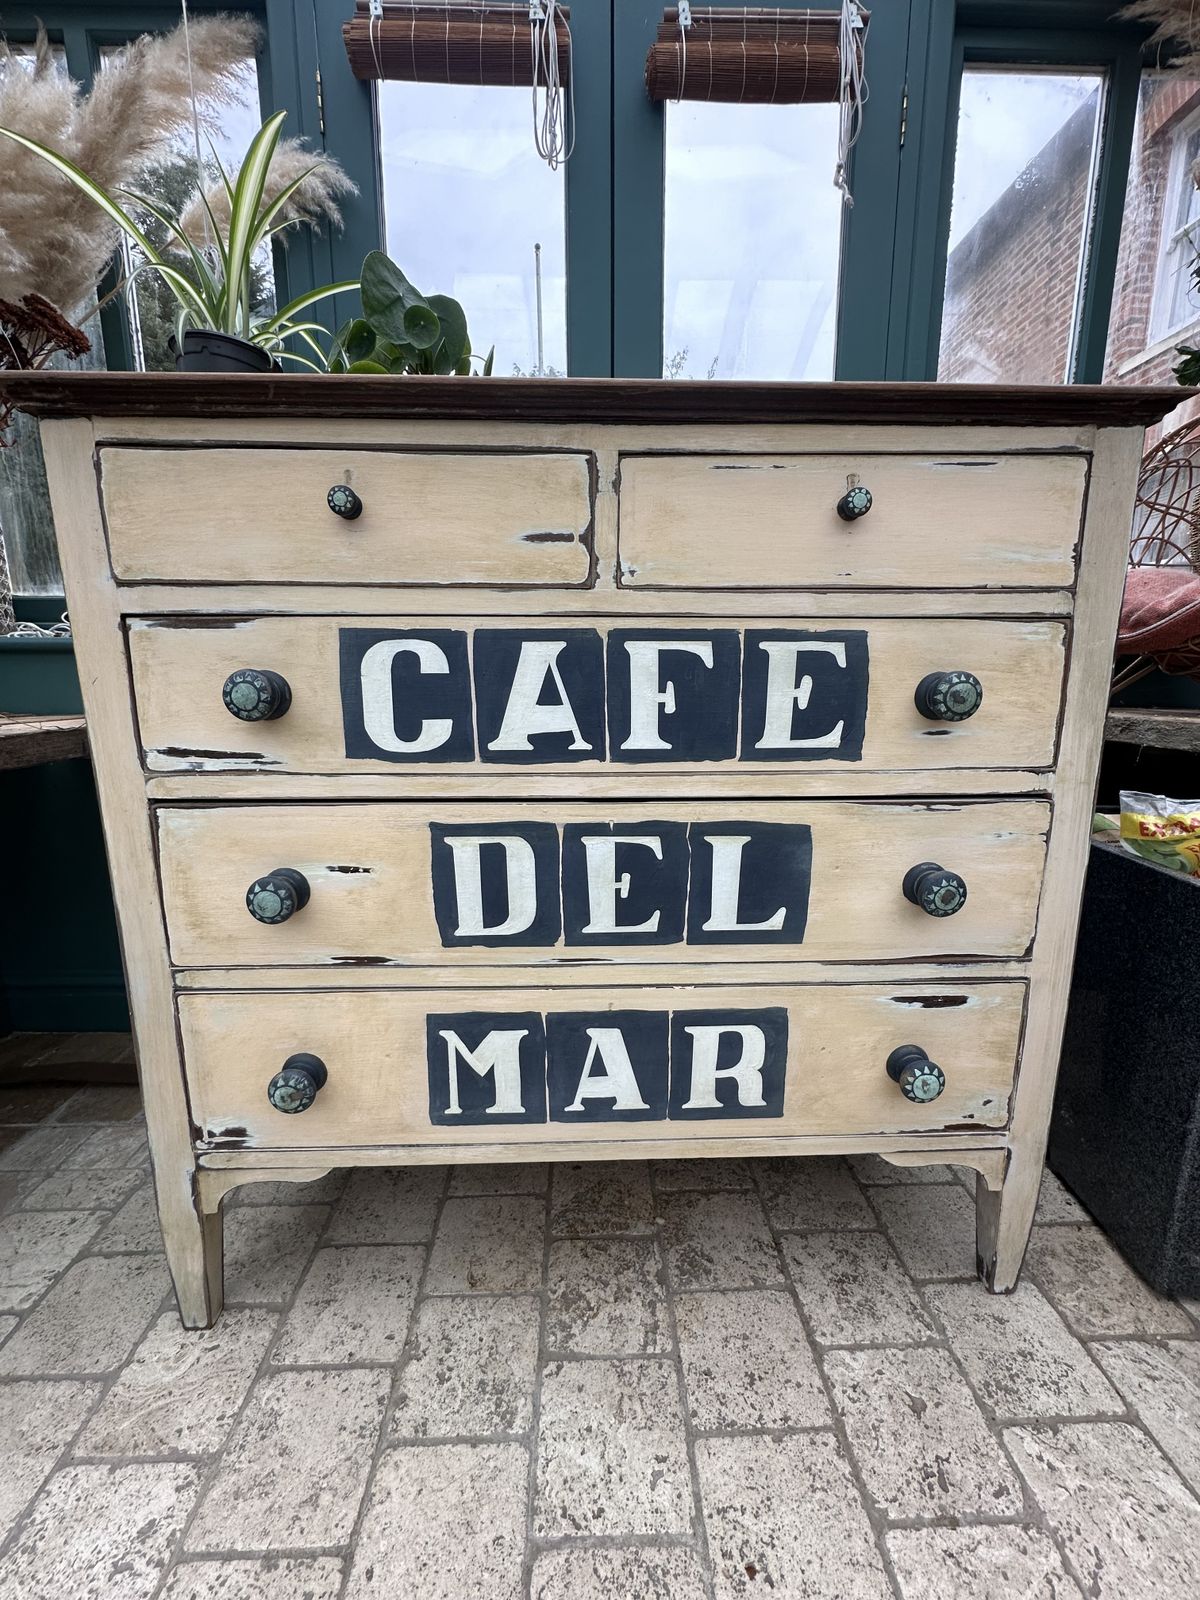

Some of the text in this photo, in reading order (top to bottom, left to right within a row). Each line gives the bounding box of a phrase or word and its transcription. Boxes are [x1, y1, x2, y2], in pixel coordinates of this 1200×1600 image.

[360, 638, 848, 753] CAFE
[443, 835, 787, 937] DEL
[438, 1024, 767, 1115] MAR
